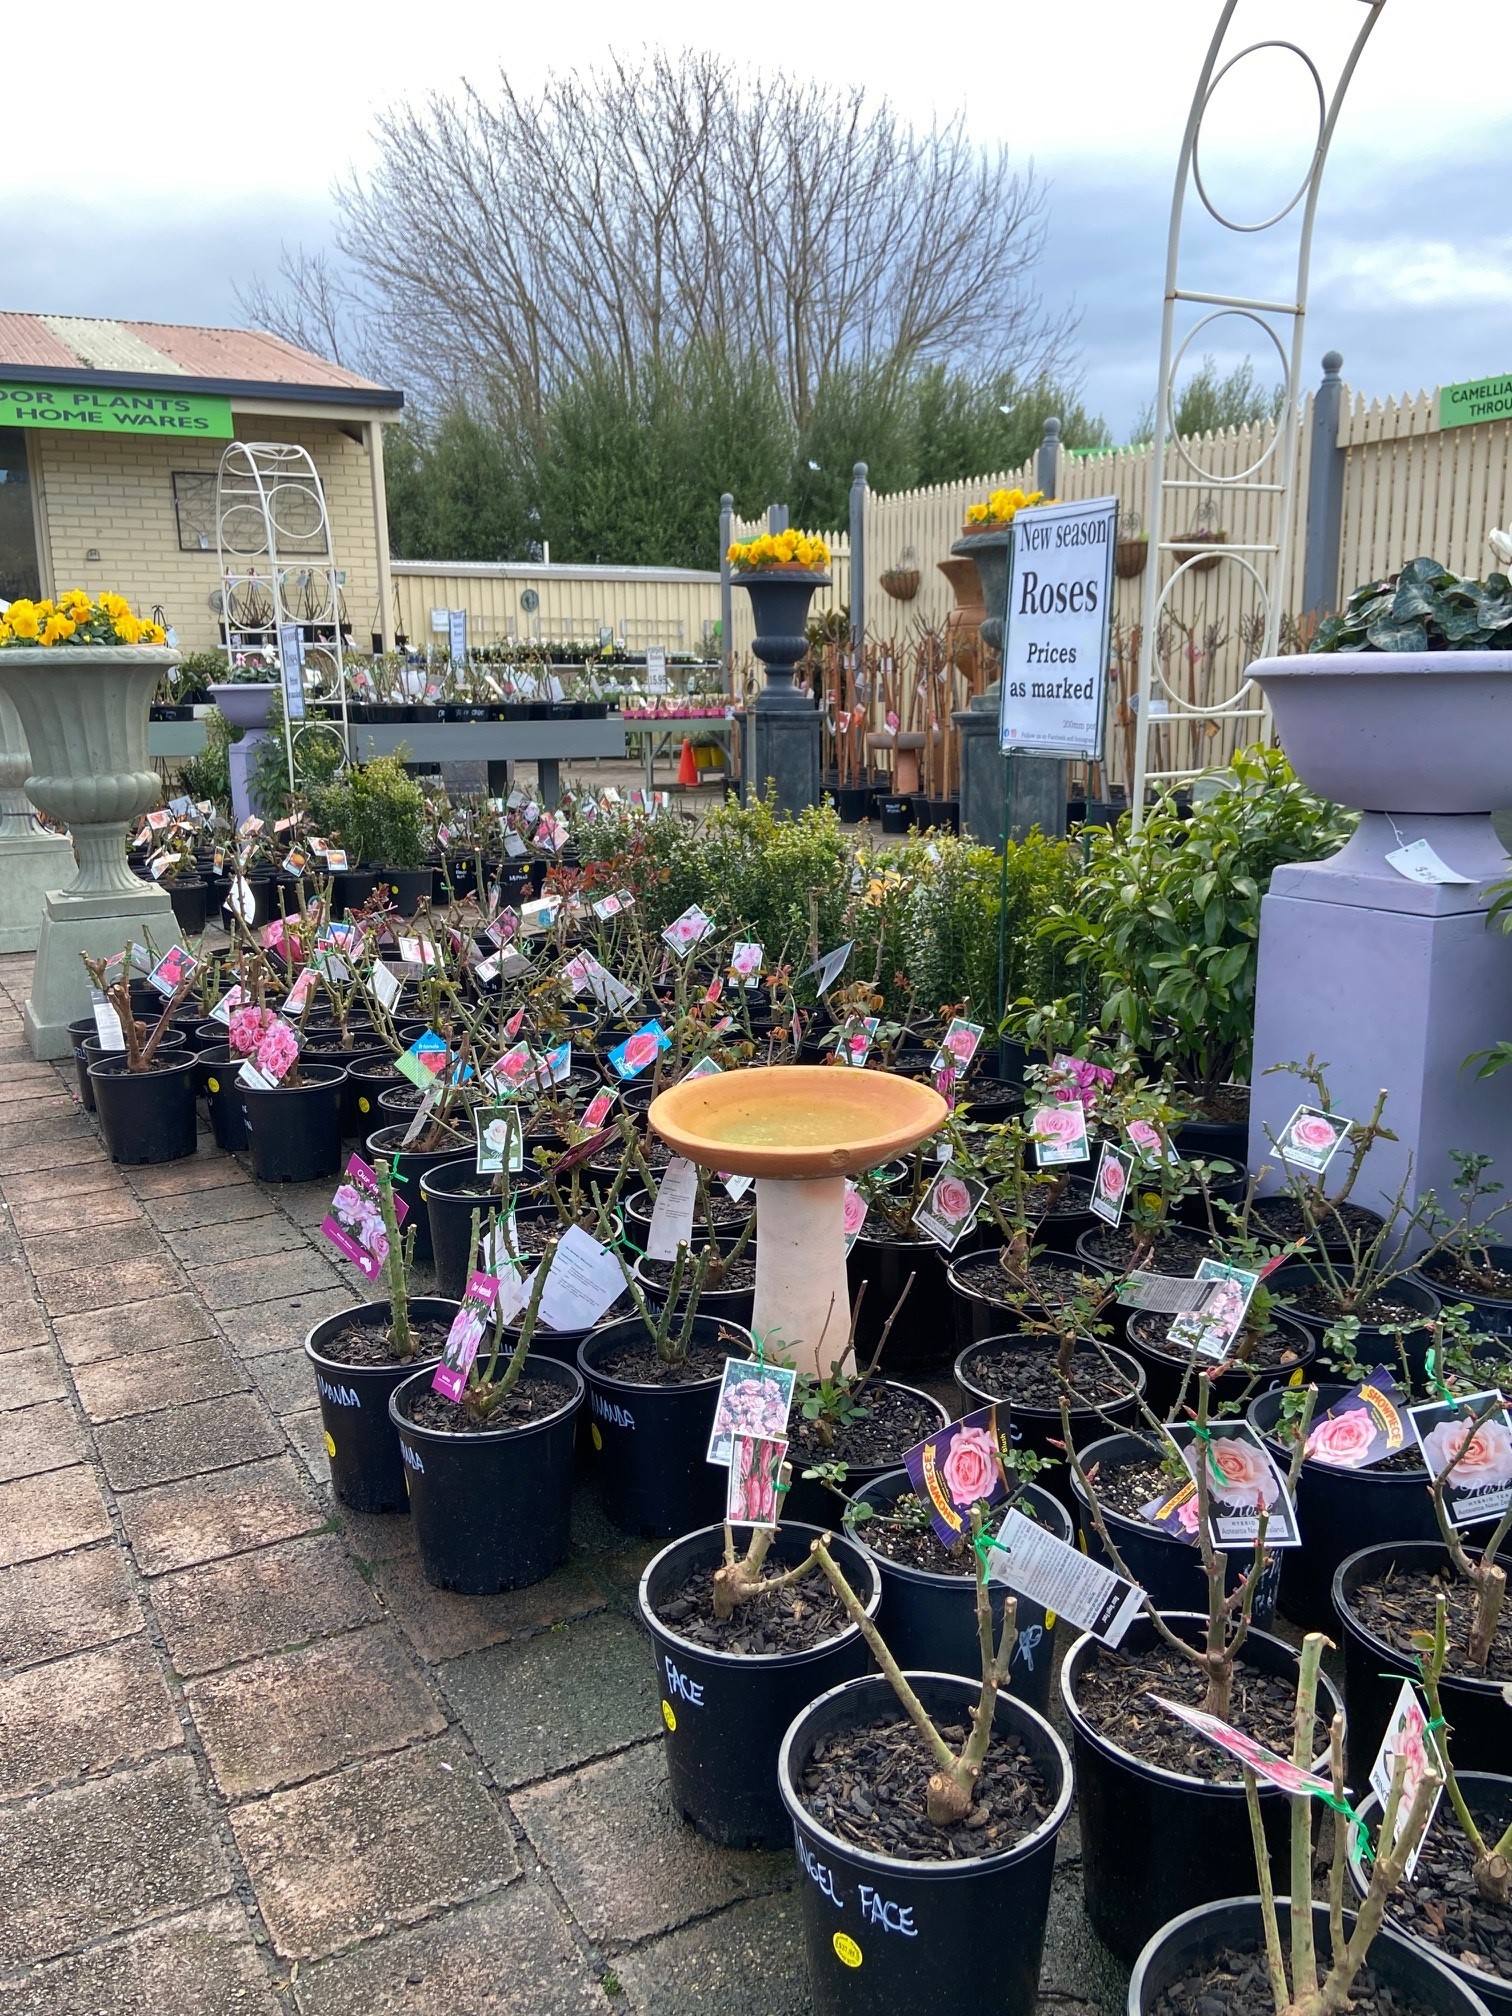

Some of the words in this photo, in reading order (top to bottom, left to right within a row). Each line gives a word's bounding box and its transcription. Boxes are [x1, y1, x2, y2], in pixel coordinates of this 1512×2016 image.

[16, 407, 103, 423] HOME
[113, 412, 210, 430] WARES
[73, 394, 191, 412] PLANTS
[1020, 521, 1053, 552] New
[1055, 519, 1107, 549] season
[1018, 571, 1099, 615] Roses
[1026, 641, 1077, 664] Prices
[1009, 681, 1026, 698] as
[1031, 676, 1095, 700] marked
[357, 1169, 371, 1184] Our
[1366, 1388, 1401, 1440] SHOWPIECE
[924, 1453, 957, 1526] SHOWPIECE
[664, 1654, 705, 1707] FACE
[857, 1883, 919, 1937] FACE
